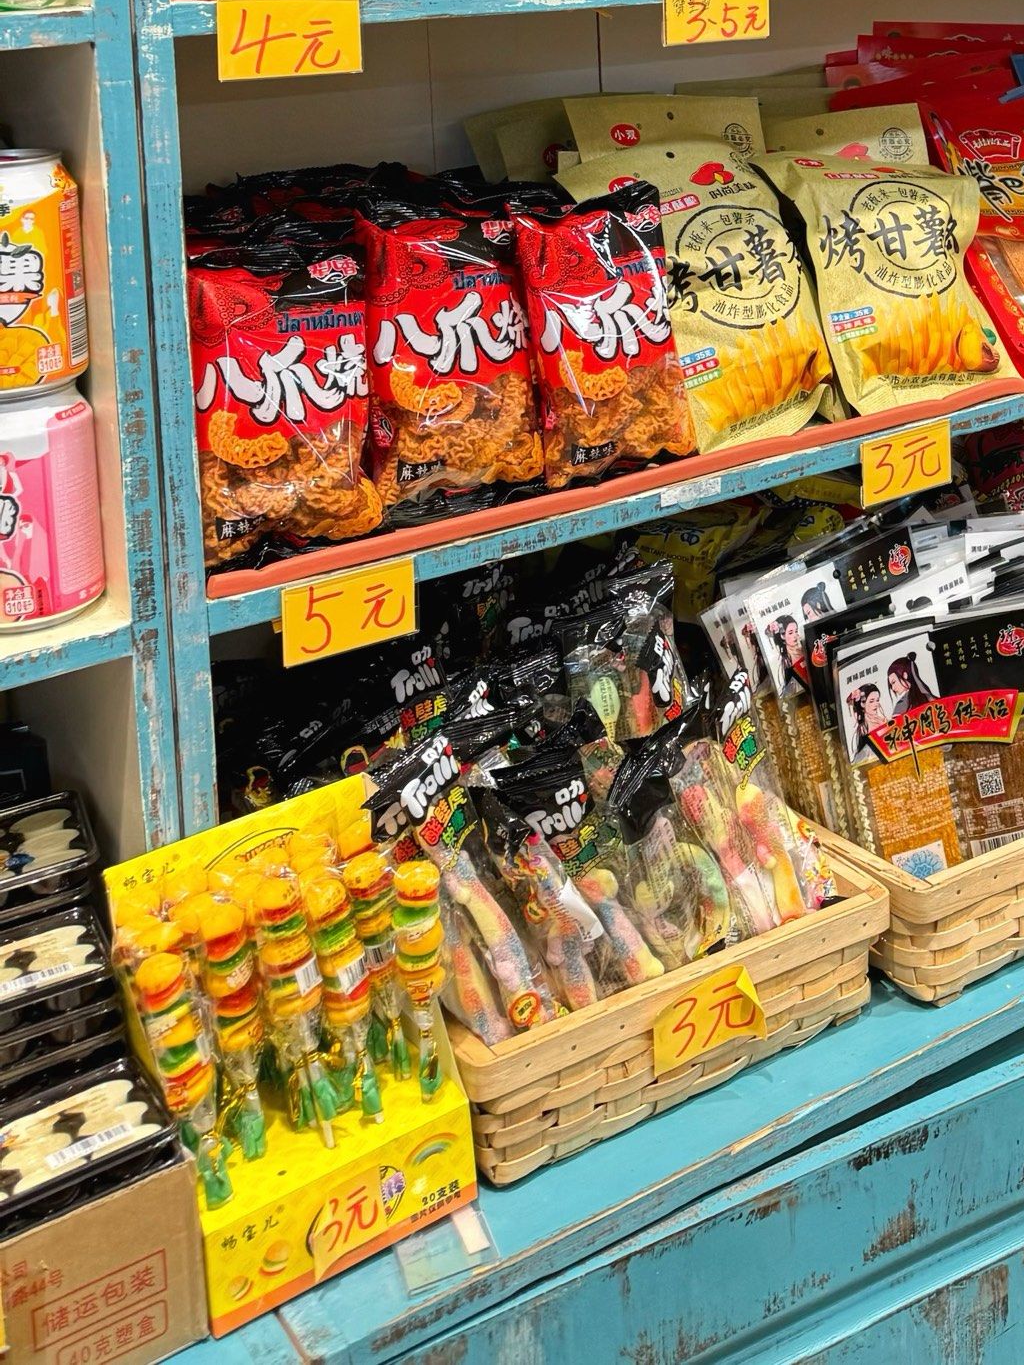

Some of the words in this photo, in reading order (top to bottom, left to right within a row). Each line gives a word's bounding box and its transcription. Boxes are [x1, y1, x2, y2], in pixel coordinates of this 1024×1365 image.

[230, 9, 341, 74] 4元
[612, 126, 639, 142] 小双
[709, 181, 757, 199] 时尚美味
[874, 262, 954, 289] 油炸型膨化食品
[711, 284, 795, 321] 油炸型膨化食品
[196, 335, 370, 424] 八爪烧
[575, 441, 618, 467] 麻辣味
[873, 434, 943, 496] 3元
[300, 583, 406, 656] 5元
[390, 657, 441, 704] Trolli
[420, 734, 449, 766] 口力
[400, 745, 460, 819] Trolli
[554, 778, 585, 806] 口力
[524, 793, 588, 836] Trolli
[670, 982, 756, 1059] 3元
[420, 1179, 461, 1207] 20支装
[40, 1266, 158, 1332] 储运包装
